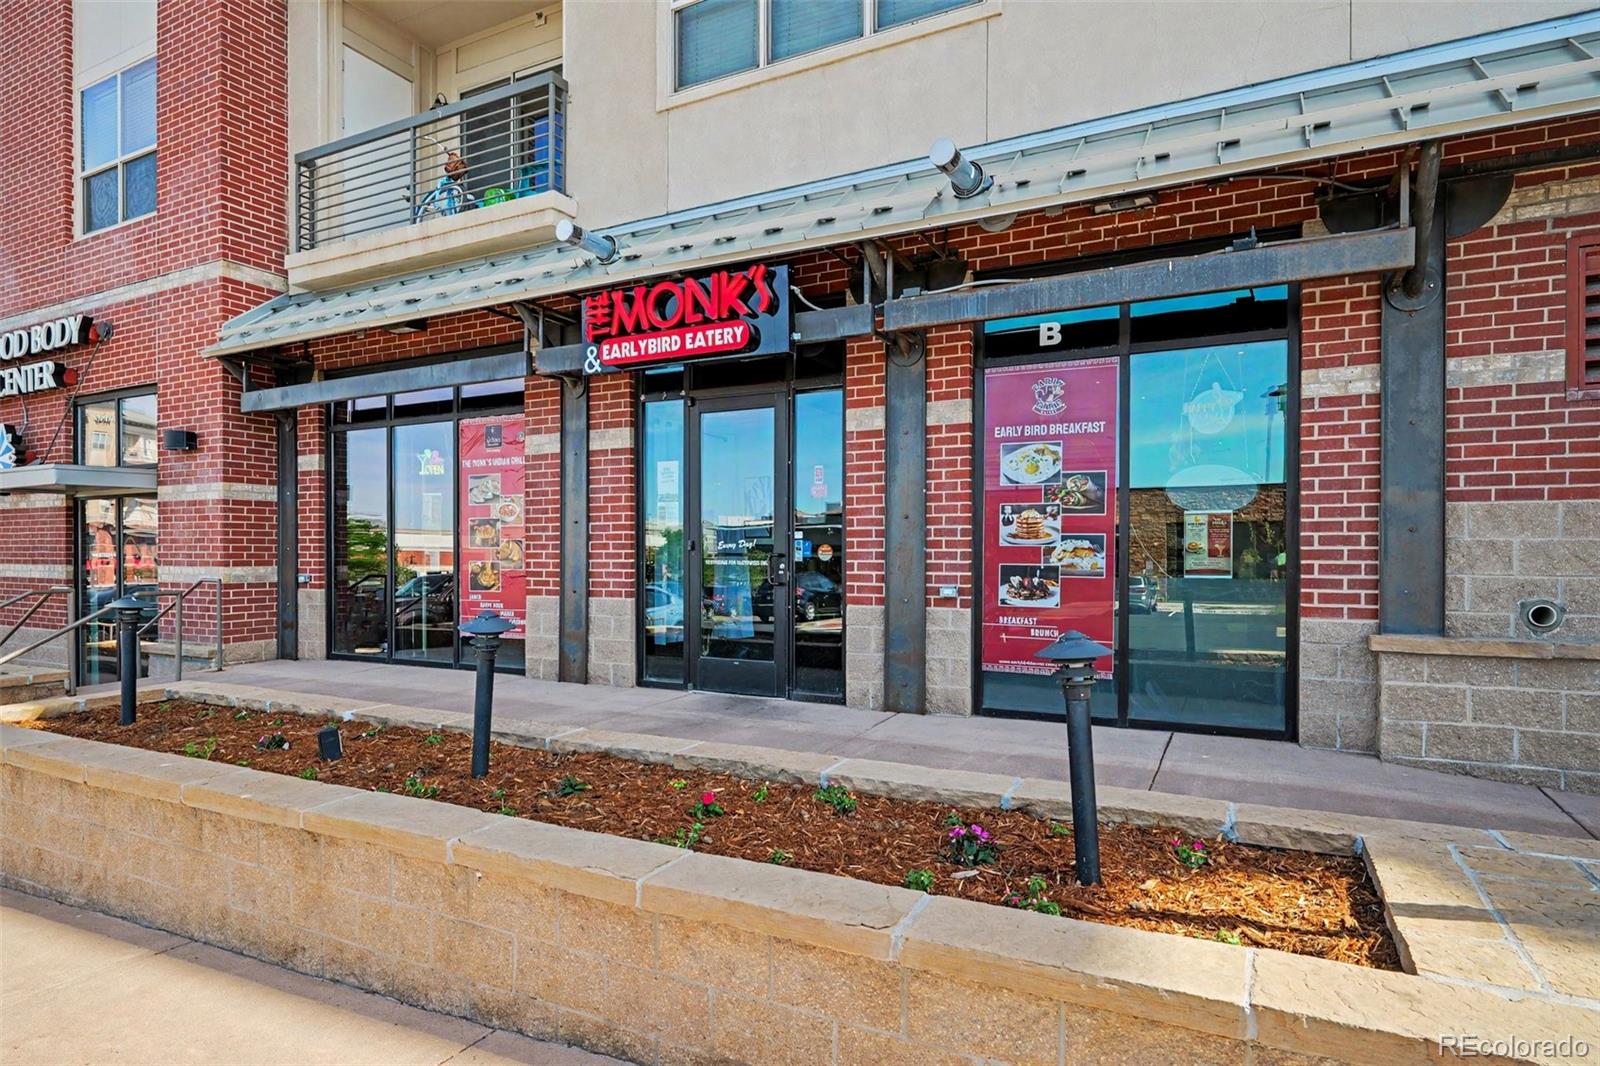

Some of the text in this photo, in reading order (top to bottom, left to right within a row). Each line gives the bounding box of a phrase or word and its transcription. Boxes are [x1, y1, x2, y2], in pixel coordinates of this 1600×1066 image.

[585, 263, 771, 343] THE MONK'S
[0, 314, 83, 361] OD BODY
[584, 325, 745, 374] & EARLYBIRD EATERY
[1039, 322, 1062, 347] B
[0, 360, 57, 397] CENTER
[994, 421, 1107, 438] EARLY BIRD BREAKFAST
[998, 616, 1038, 625] BREAKFAST
[1030, 628, 1060, 638] BRUNCH
